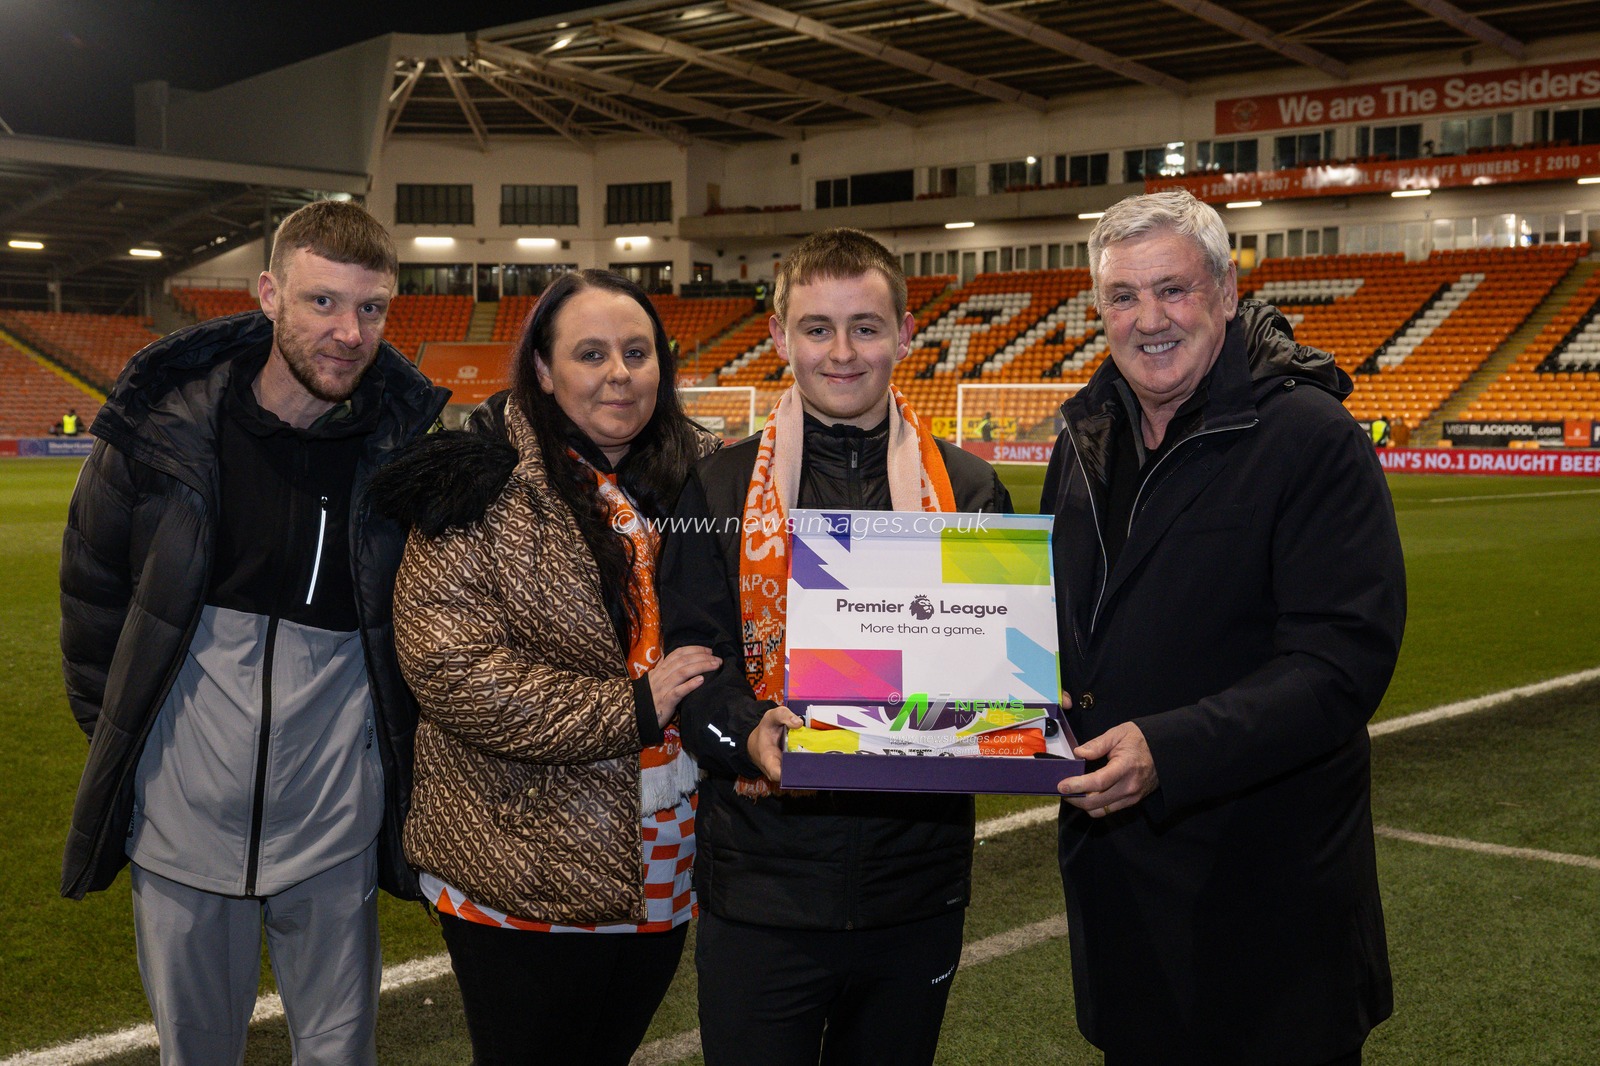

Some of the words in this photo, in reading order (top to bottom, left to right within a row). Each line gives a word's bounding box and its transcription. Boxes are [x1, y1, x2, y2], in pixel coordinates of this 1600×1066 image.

[1279, 96, 1323, 124] We
[1330, 96, 1375, 120] are
[1381, 85, 1436, 114] The
[1444, 70, 1600, 107] Seasiders
[1461, 160, 1520, 176] WINNERS
[1547, 155, 1580, 170] 2010
[994, 446, 1043, 460] SPAIN'S
[1380, 452, 1421, 469] AIN'S
[1425, 453, 1465, 469] NO.1
[1469, 454, 1558, 471] DRAUGHT
[836, 598, 904, 613] Premier
[940, 600, 1008, 618] League
[860, 623, 894, 634] More
[897, 623, 928, 634] than
[932, 626, 940, 634] a
[943, 626, 985, 637] game.
